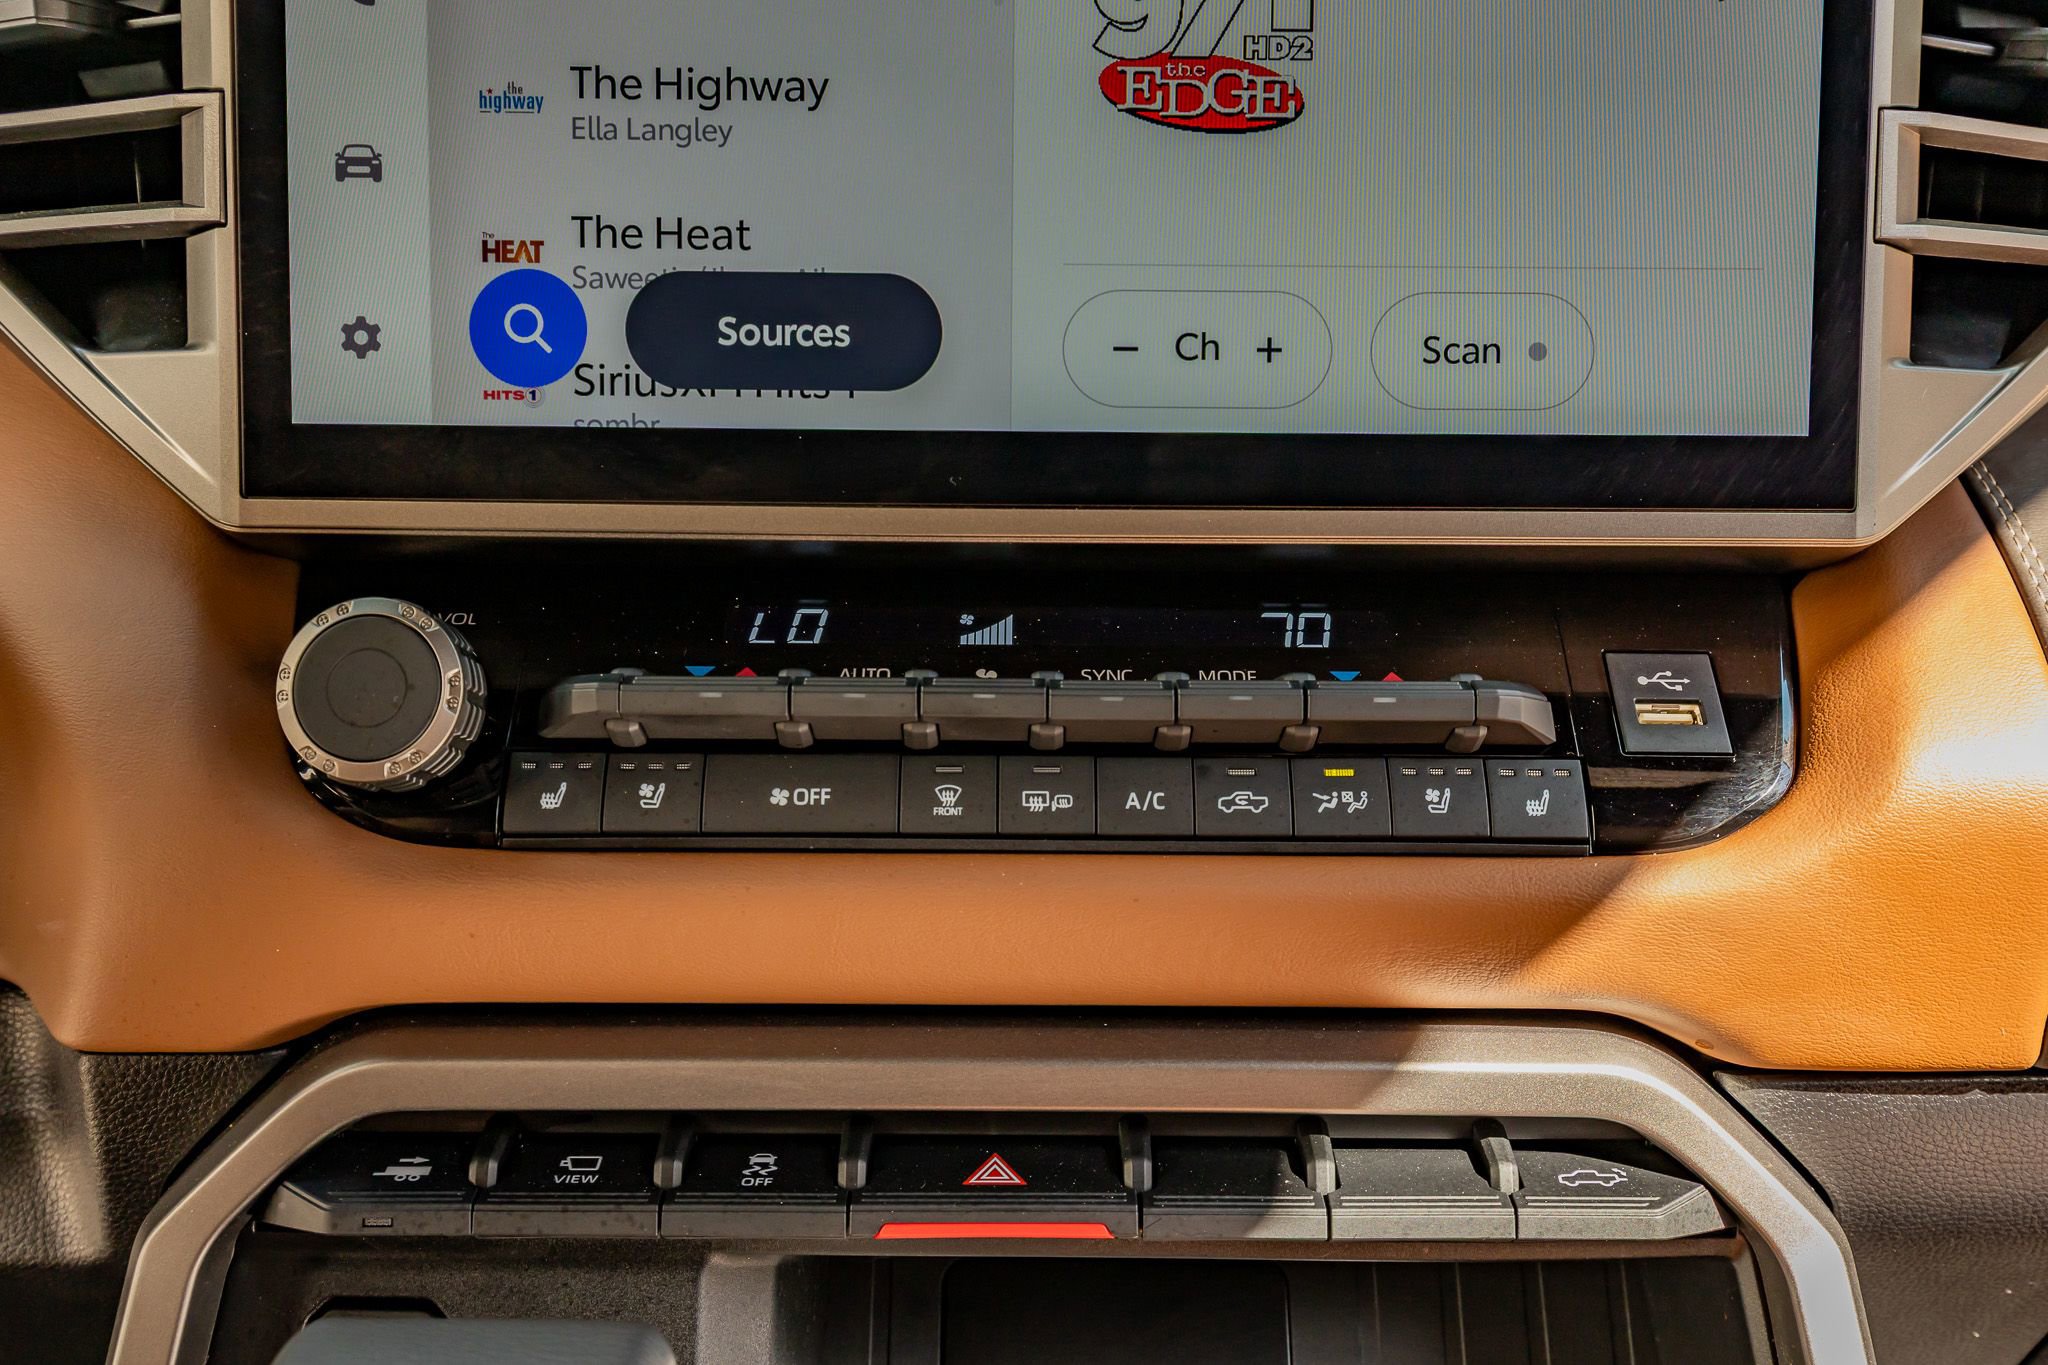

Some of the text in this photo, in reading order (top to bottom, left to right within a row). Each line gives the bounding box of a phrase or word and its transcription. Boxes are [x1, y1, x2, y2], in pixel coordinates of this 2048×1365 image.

[1243, 35, 1313, 61] HD2
[1166, 62, 1205, 77] the
[507, 81, 523, 94] the
[570, 65, 830, 111] The Highway
[1116, 66, 1296, 119] EDGE
[479, 88, 544, 114] highway
[571, 116, 733, 148] Ella Langley
[571, 215, 751, 251] The Heat
[482, 240, 545, 263] HEAT
[717, 316, 851, 348] Sources
[1174, 332, 1221, 362] Ch
[1422, 336, 1502, 365] Scan
[483, 390, 525, 401] HITS
[438, 612, 477, 625] VOL
[1261, 611, 1332, 649] 70
[840, 667, 891, 678] AUTO
[1081, 668, 1133, 681] SYNC
[1199, 669, 1257, 681] MODE
[793, 787, 831, 807] OFF
[1125, 791, 1166, 812] A/C
[933, 805, 963, 817] FRONT
[554, 1173, 600, 1185] VIEW
[741, 1176, 774, 1188] OFF
